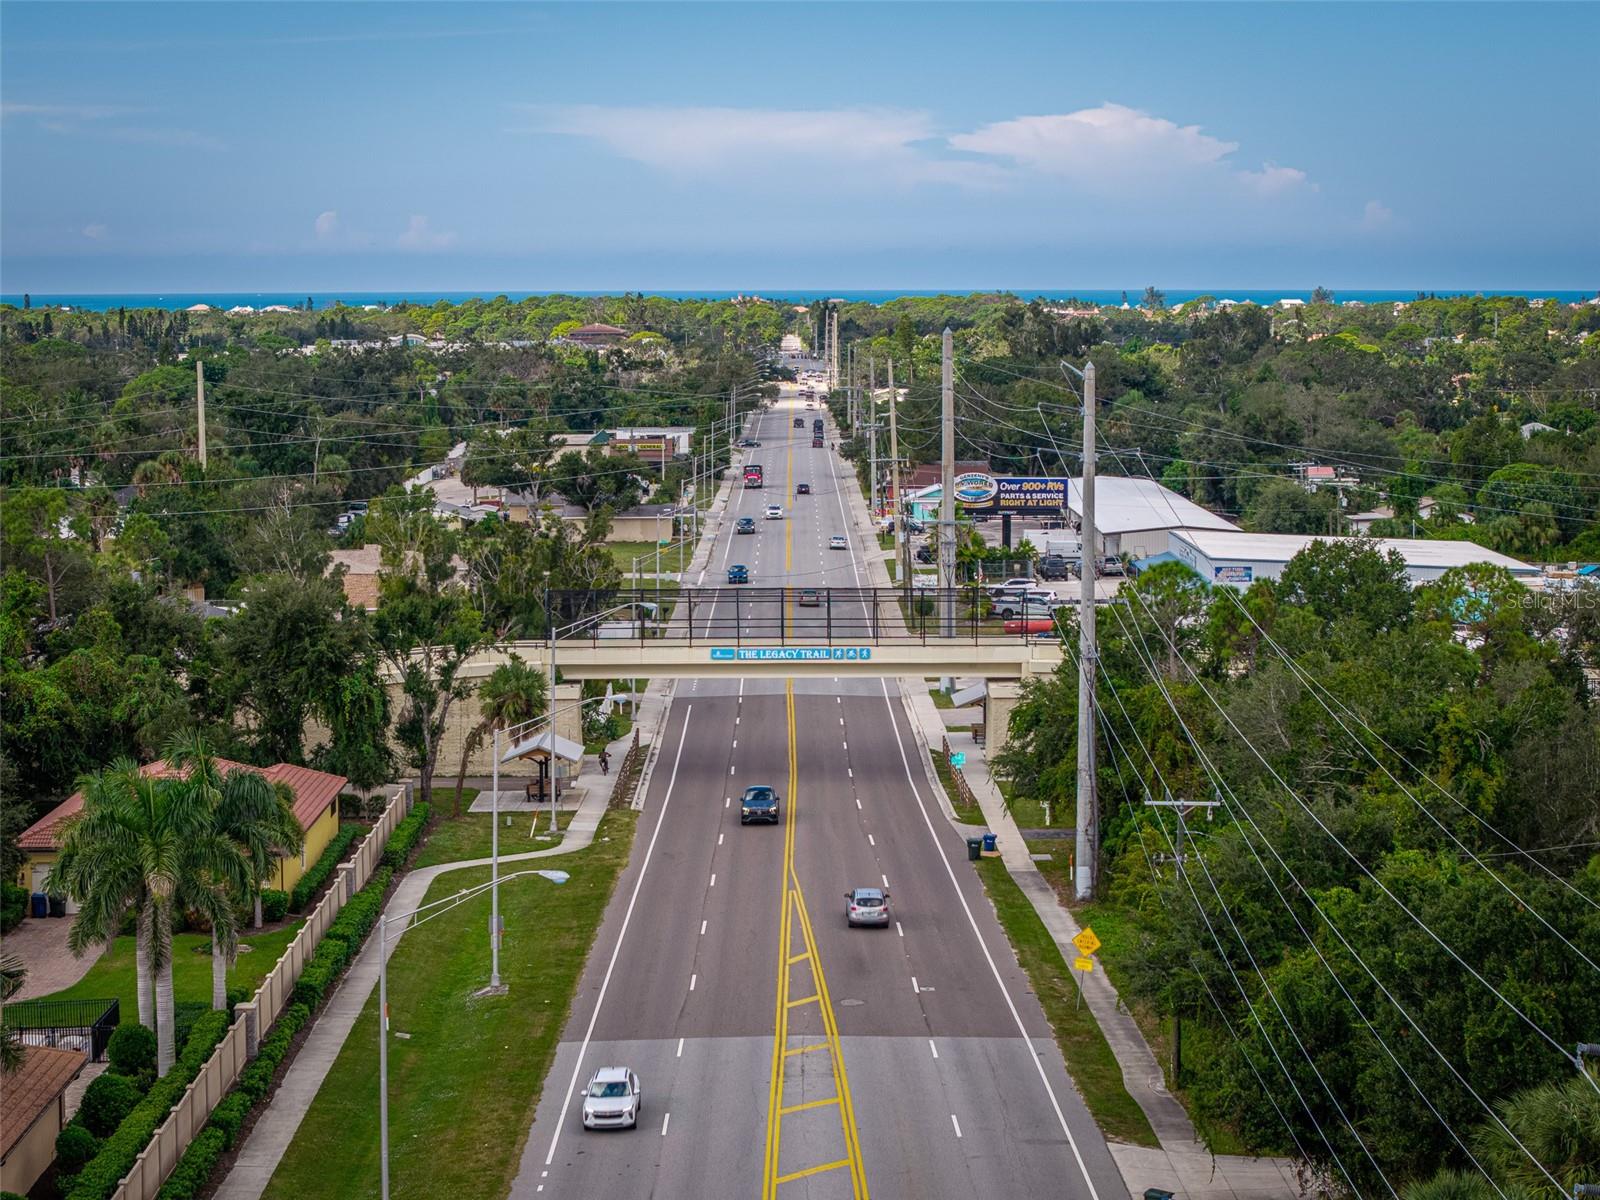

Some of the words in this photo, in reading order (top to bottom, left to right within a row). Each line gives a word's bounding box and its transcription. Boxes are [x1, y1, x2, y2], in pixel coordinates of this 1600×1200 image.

[1000, 482, 1020, 491] Over
[1022, 482, 1045, 491] 900+
[1046, 482, 1065, 491] RVs
[739, 650, 758, 659] THE
[760, 650, 799, 659] LEGACY
[800, 650, 829, 659] TRAIL
